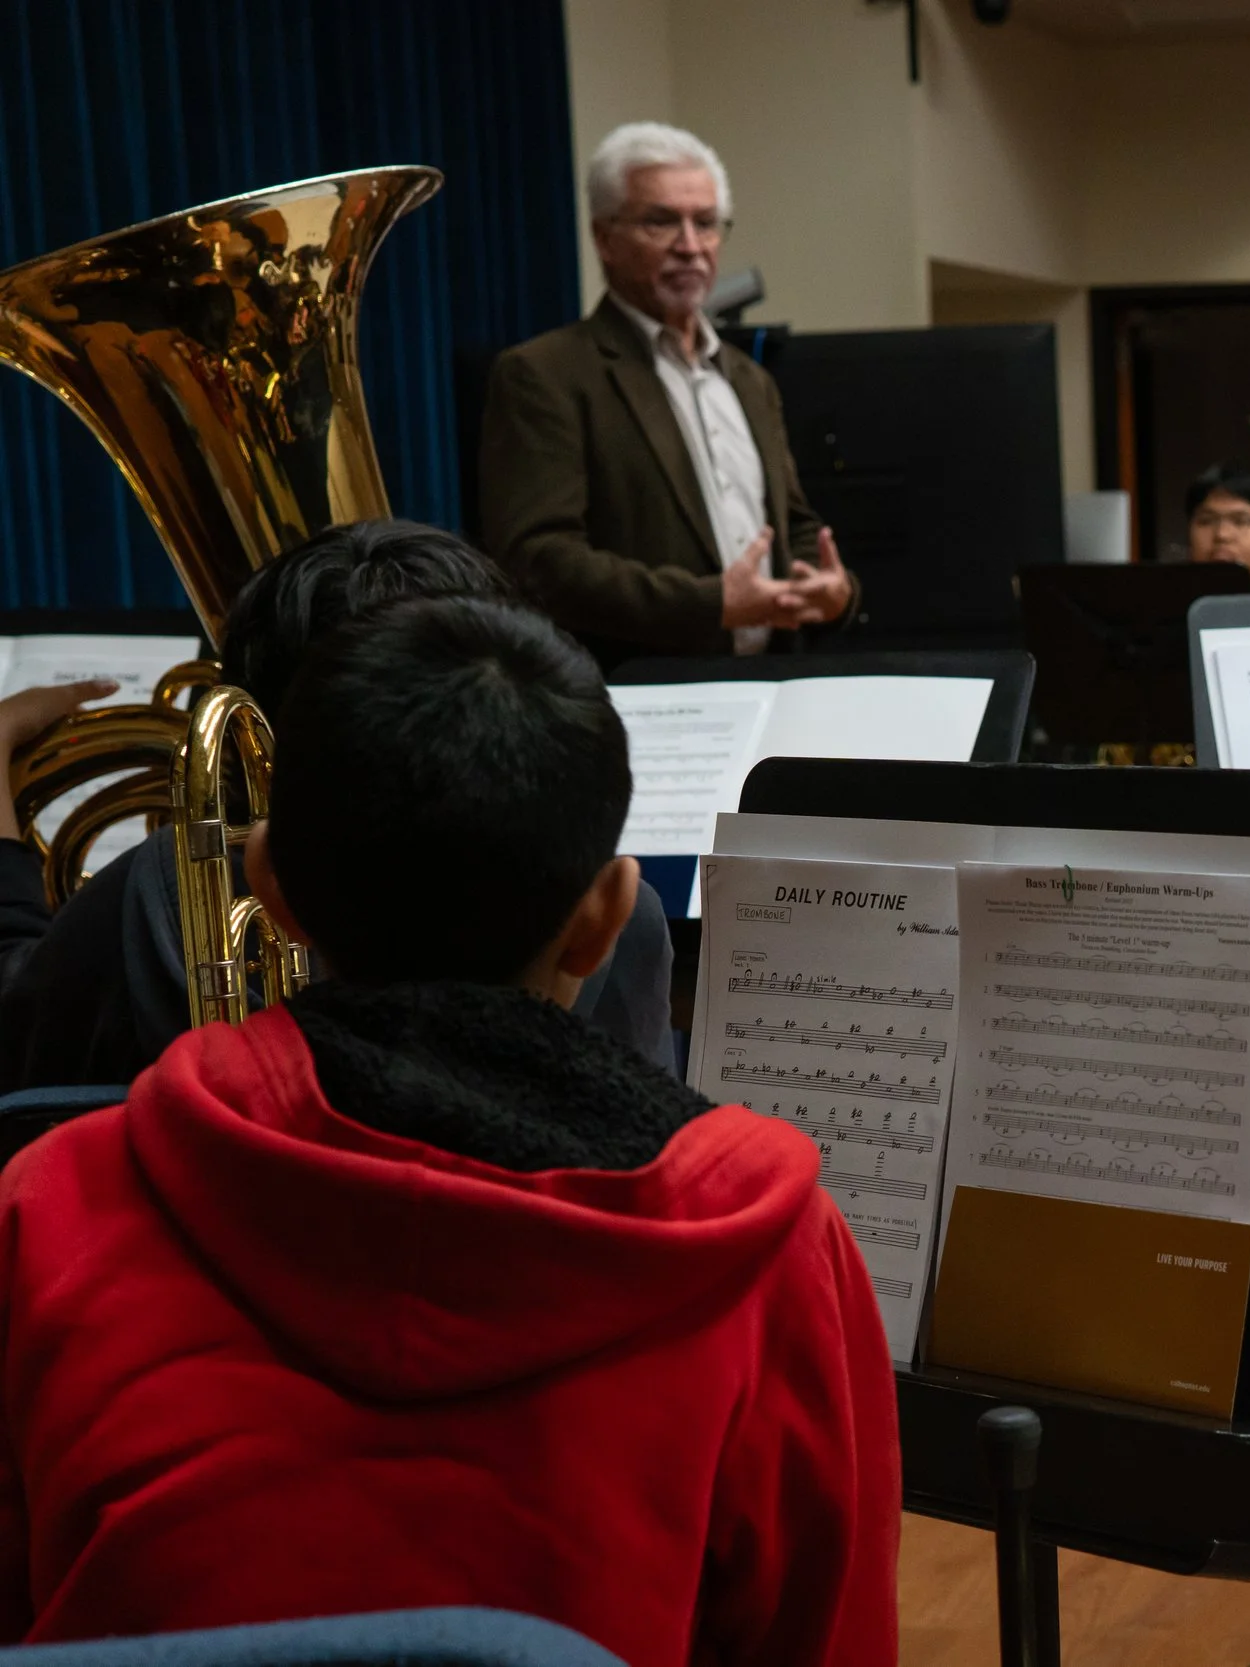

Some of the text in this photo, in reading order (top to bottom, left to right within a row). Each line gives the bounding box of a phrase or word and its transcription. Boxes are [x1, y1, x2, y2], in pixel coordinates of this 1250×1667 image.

[775, 886, 908, 912] DAILY ROUTINE
[1025, 877, 1047, 889] Bass
[1050, 878, 1098, 892] Trmbone
[1106, 882, 1160, 897] Euphonium
[1163, 885, 1214, 901] Warm-Ups
[738, 906, 786, 921] TROMBONE
[897, 921, 960, 937] by William Ada
[1156, 1252, 1228, 1273] LIVE YOUR PURPOSE
